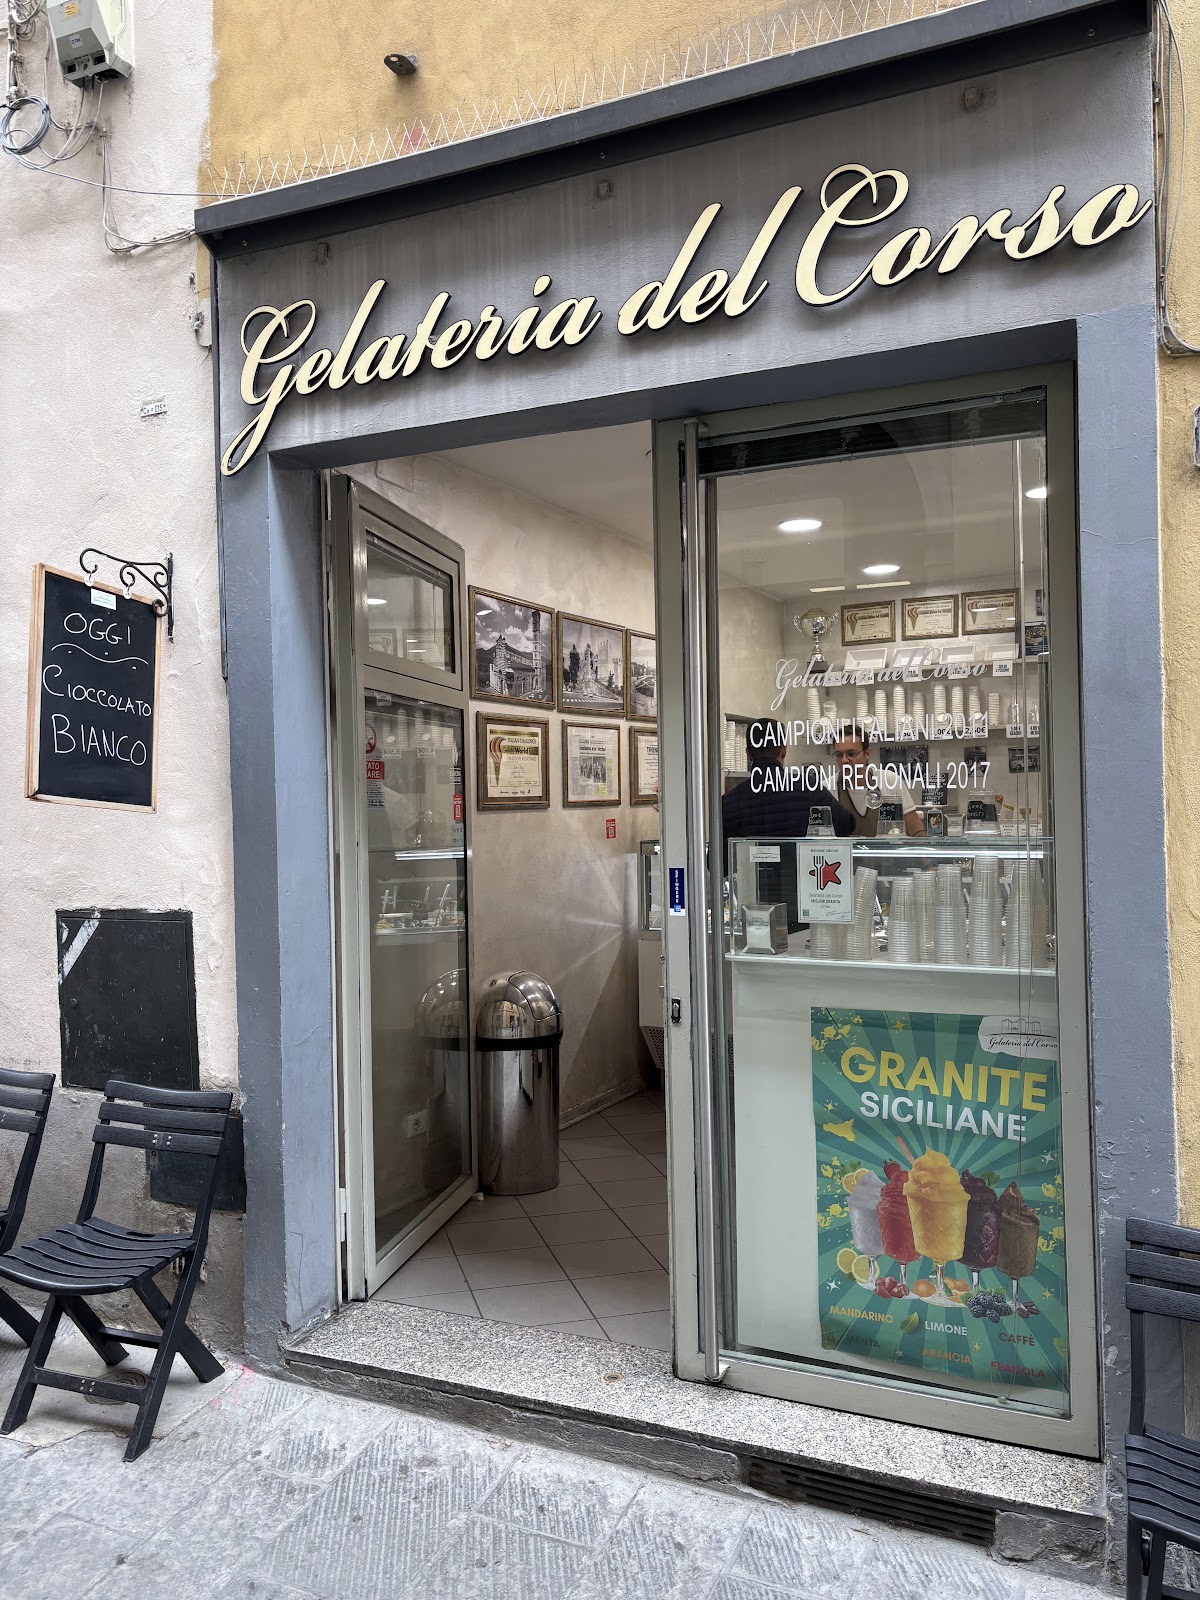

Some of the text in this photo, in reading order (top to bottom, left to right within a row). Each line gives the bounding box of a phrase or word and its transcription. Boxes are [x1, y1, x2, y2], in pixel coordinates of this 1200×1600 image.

[221, 163, 1153, 476] Gelateria del Corso
[63, 612, 131, 645] OGGI
[51, 713, 147, 766] BIANCO
[750, 711, 988, 749] CAMPIONI ITALIANI 2011
[366, 761, 380, 770] ATO
[750, 764, 836, 794] CAMPIONI
[842, 762, 940, 791] REGIONALI
[946, 761, 991, 789] 2017
[988, 1036, 1058, 1050] Gelateria del Corso
[840, 1046, 1048, 1112] GRANITE
[859, 1091, 1027, 1142] SICILIANE
[829, 1305, 894, 1324] MANDARINO
[924, 1320, 968, 1336] LIMONE
[998, 1332, 1035, 1347] CAFFÈ
